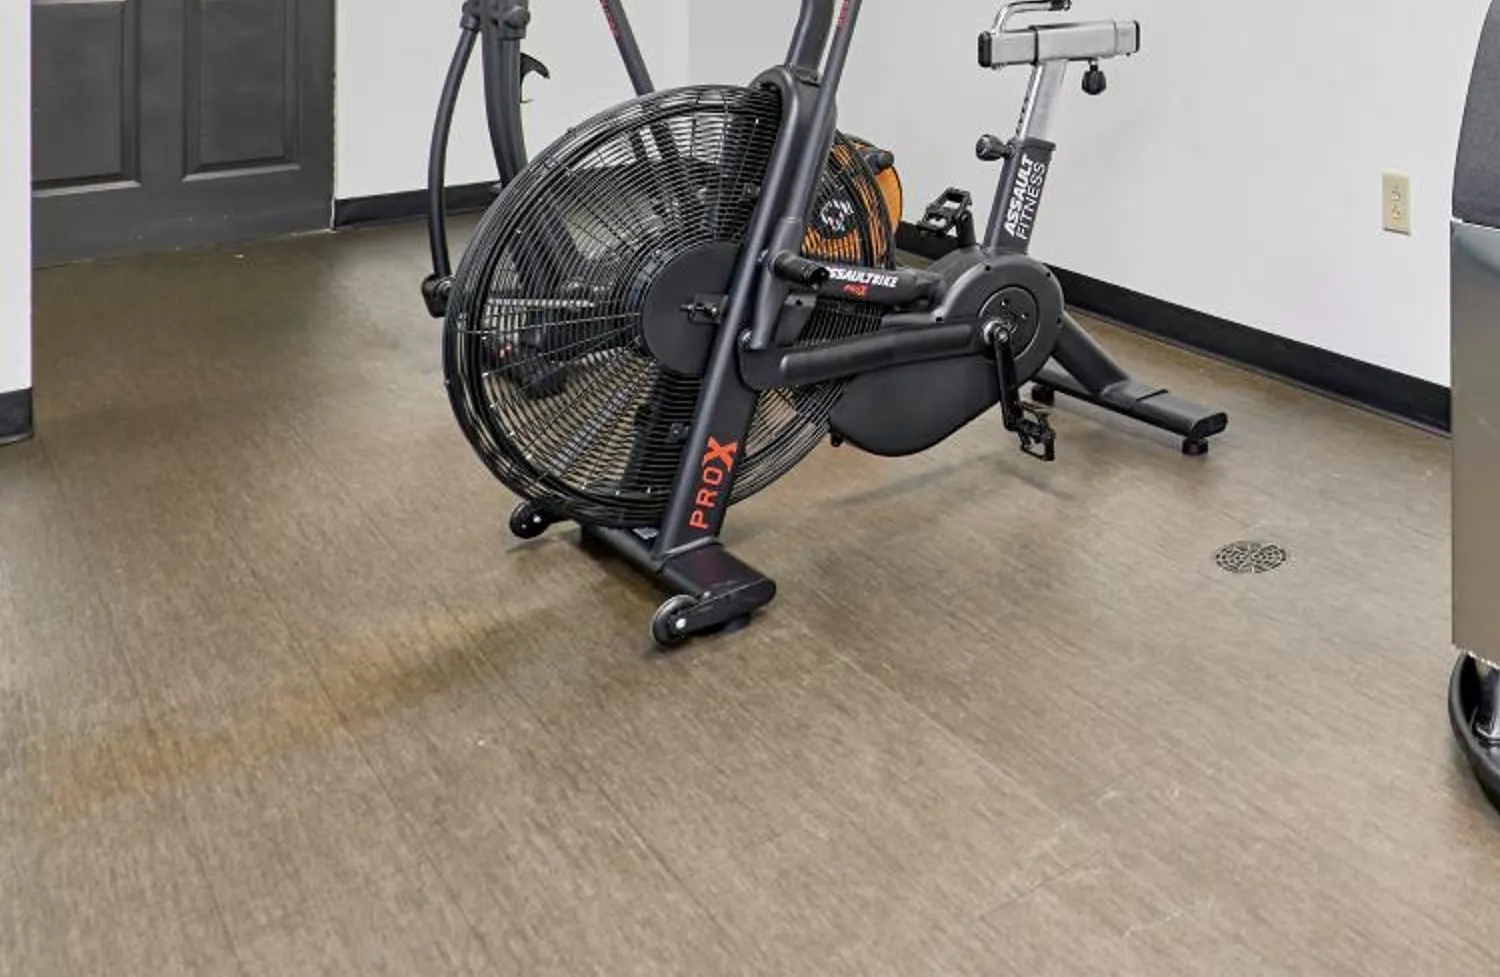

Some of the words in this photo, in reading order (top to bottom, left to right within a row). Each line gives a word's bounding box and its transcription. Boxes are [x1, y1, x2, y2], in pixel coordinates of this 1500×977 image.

[1004, 154, 1034, 237] ASSAULT
[1015, 162, 1046, 240] FITNESS
[689, 435, 738, 529] PROX
